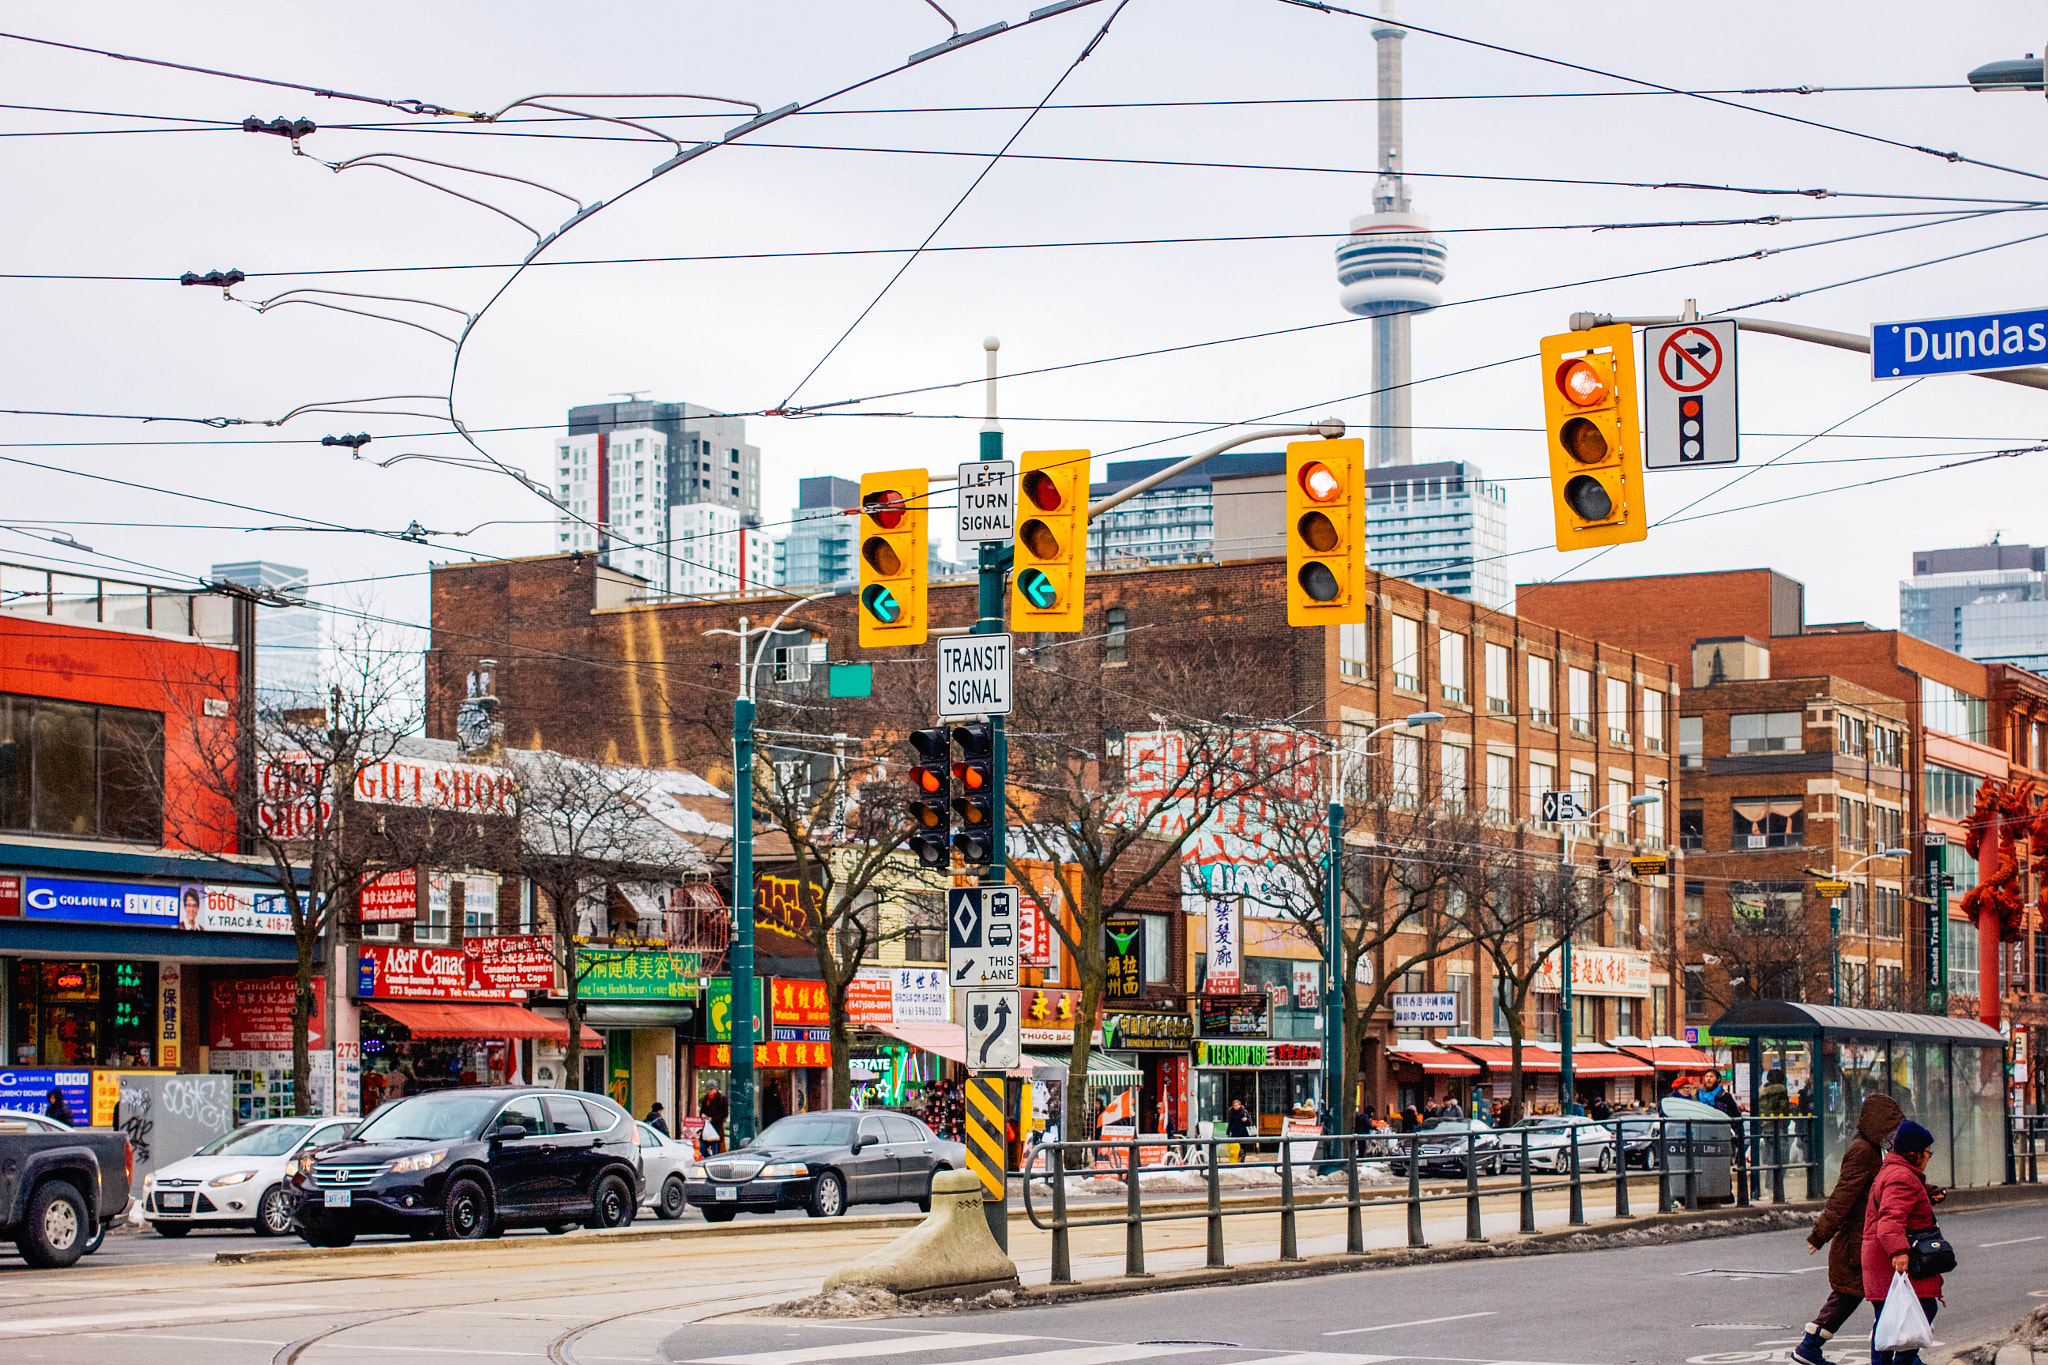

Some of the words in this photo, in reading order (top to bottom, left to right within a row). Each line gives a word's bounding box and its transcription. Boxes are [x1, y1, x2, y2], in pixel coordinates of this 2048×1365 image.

[1904, 319, 2047, 364] Dundas
[967, 472, 1005, 488] LEFT
[965, 494, 1008, 510] TURN
[961, 516, 1011, 532] SIGNAL
[943, 645, 1006, 673] TRANSIT
[948, 680, 1002, 706] SIGNAL
[263, 762, 326, 798] GIFT
[357, 758, 425, 803] GIFT
[434, 767, 515, 813] SHOP
[260, 800, 331, 838] SHOP
[1926, 836, 1944, 844] 247
[59, 895, 107, 908] GOLDIUM
[207, 891, 236, 912] 660
[218, 916, 246, 928] TRAC
[384, 948, 419, 974] A&F
[988, 956, 1014, 967] THIS
[2013, 940, 2022, 974] 241
[482, 964, 516, 974] Canadian
[517, 963, 553, 973] Souvenirs
[1931, 947, 1939, 986] Canada
[489, 974, 520, 983] T-Shirts
[526, 973, 547, 984] Caps
[982, 969, 1014, 981] LANE
[235, 980, 282, 992] Canada
[389, 985, 403, 995] 273
[404, 986, 432, 997] Spadina
[432, 987, 445, 996] Ave
[593, 983, 607, 995] Tong
[609, 984, 627, 994] Health
[1299, 984, 1319, 1008] Eat
[162, 988, 177, 1040] 保健品
[773, 1029, 797, 1040] ITIZEN
[808, 1030, 831, 1041] CITIZE
[337, 1042, 359, 1057] 273
[1210, 1044, 1227, 1065] TEA
[1227, 1044, 1250, 1065] SHOP
[1251, 1044, 1267, 1066] 168
